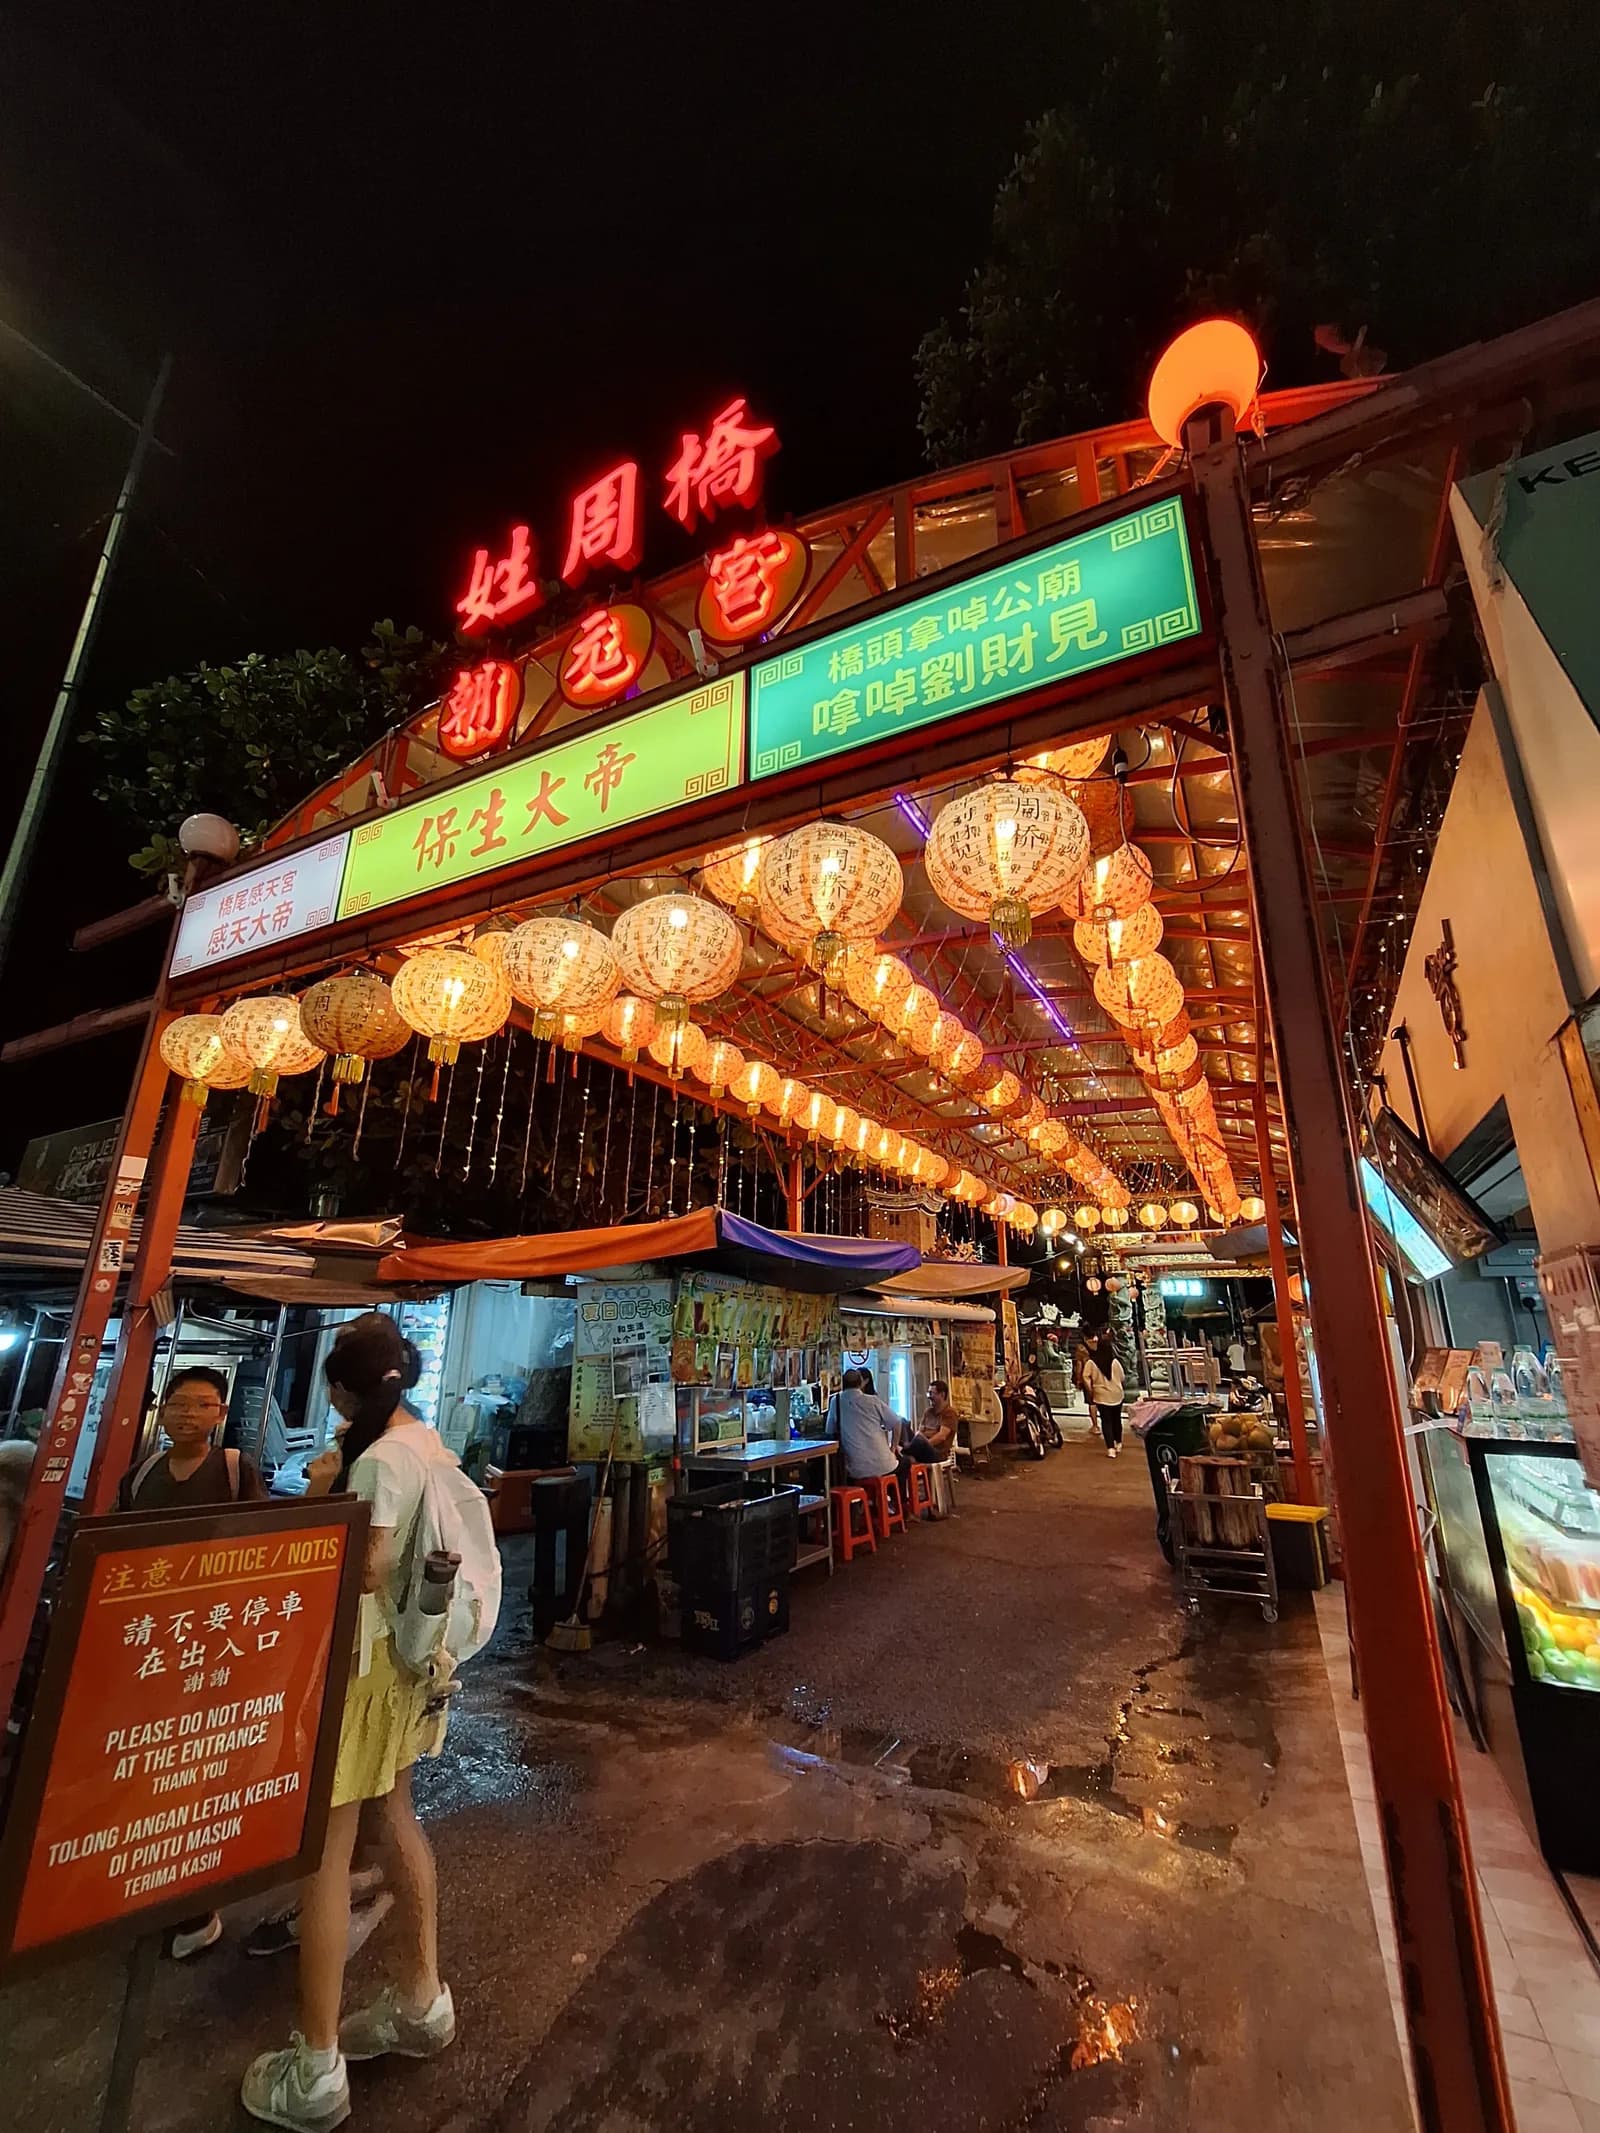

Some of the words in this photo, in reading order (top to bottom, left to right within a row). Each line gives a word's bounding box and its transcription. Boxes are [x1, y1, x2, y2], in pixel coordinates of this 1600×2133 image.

[457, 399, 775, 630] 姓周橋
[441, 531, 784, 738] 朝元宮
[412, 742, 637, 872] 保生大帝
[219, 869, 298, 918] 橋尾感天宮
[206, 900, 294, 956] 感天大帝
[103, 1557, 173, 1594] 注意
[200, 1546, 268, 1577] NOTICE
[287, 1537, 339, 1564] NOTIS
[123, 1590, 303, 1647] 請不要停車
[134, 1630, 280, 1680] 在出入口
[183, 1667, 231, 1694] 謝謝
[105, 1719, 175, 1754] PLEASE
[178, 1710, 203, 1733] DO
[206, 1702, 242, 1728] NOT
[243, 1691, 286, 1722] PARK
[113, 1756, 140, 1782] AT
[142, 1746, 178, 1776] THE
[181, 1720, 270, 1764] ENTRANCE
[152, 1766, 198, 1796] THANK
[201, 1758, 228, 1782] YOU
[48, 1828, 118, 1868] TOLONG
[121, 1808, 188, 1846] JANGAN
[191, 1787, 242, 1823] LETAK
[244, 1771, 300, 1807] KERETA
[108, 1853, 128, 1879] DI
[130, 1834, 183, 1872] PINTU
[186, 1815, 243, 1848] MASUK
[124, 1865, 176, 1899] TERIMA
[180, 1849, 222, 1879] KASIH
